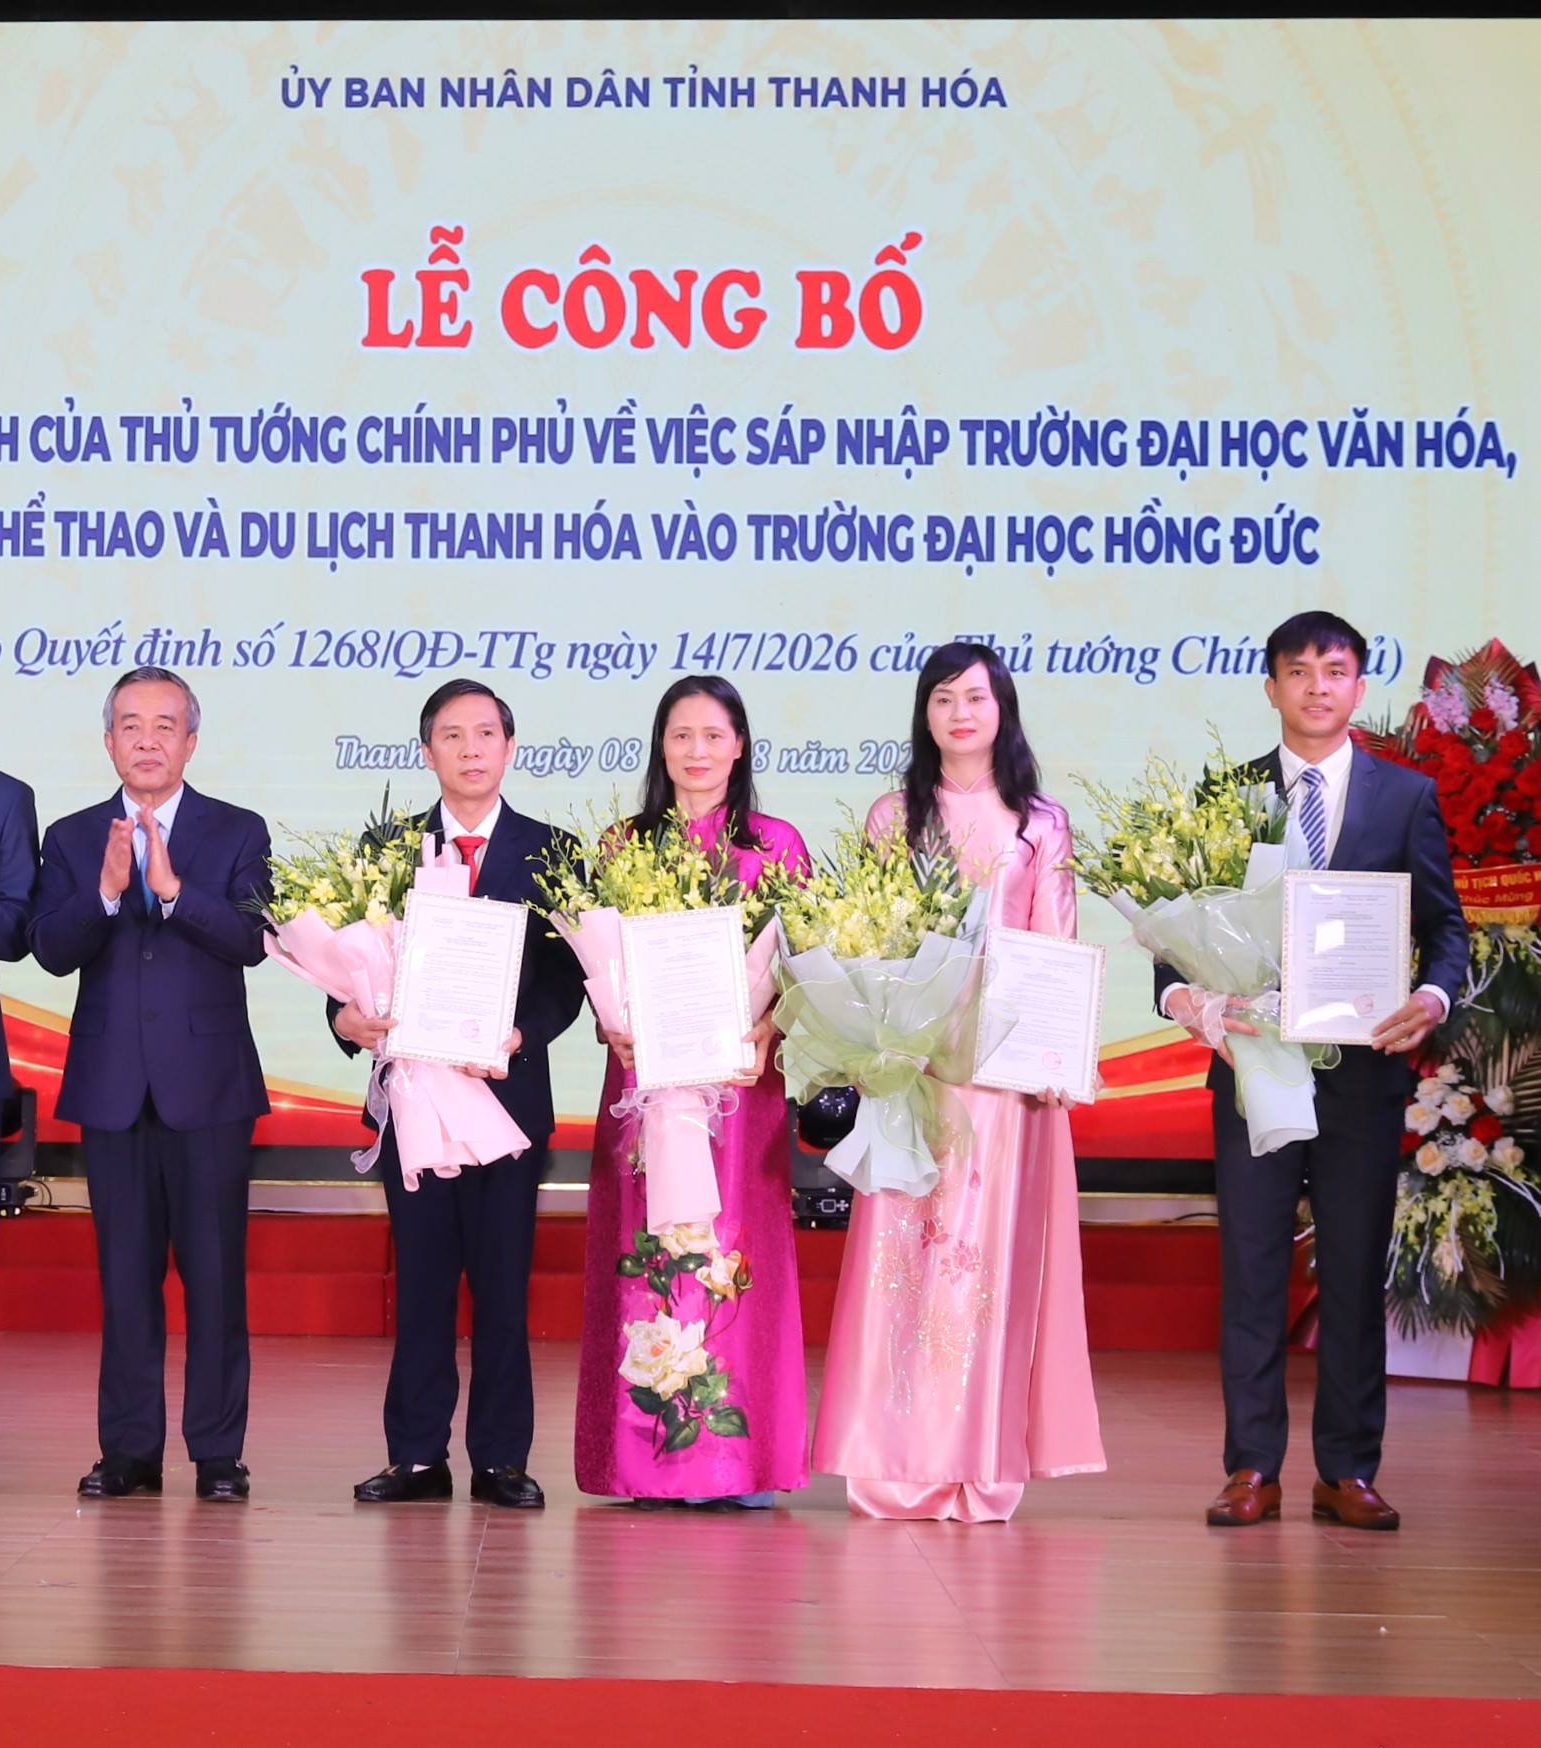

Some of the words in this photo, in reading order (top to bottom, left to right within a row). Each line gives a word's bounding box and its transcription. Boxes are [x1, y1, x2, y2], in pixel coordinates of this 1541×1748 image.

[282, 65, 332, 110] ỦY
[345, 78, 426, 110] BAN
[441, 70, 553, 109] NHÂN
[567, 69, 651, 109] DÂN
[663, 64, 757, 109] TỈNH
[768, 77, 907, 109] THANH
[922, 68, 1009, 110] HÓA
[361, 226, 474, 349] LỄ
[502, 245, 769, 351] CÔNG
[795, 232, 924, 351] BỐ
[30, 397, 113, 464] CỦA
[120, 398, 201, 465] THỦ
[210, 402, 348, 466] TƯỚNG
[357, 402, 482, 466] CHÍNH
[492, 399, 576, 466] PHỦ
[584, 399, 639, 466] VỀ
[646, 404, 738, 480] VIỆC
[746, 404, 828, 467] SÁP
[837, 405, 952, 481] NHẬP
[960, 405, 1129, 469] TRƯỜNG
[1137, 420, 1211, 483] ĐẠI
[1221, 420, 1310, 483] HỌC
[1317, 408, 1405, 469] VĂN
[1416, 407, 1518, 481] HÓA,
[54, 510, 166, 560] THAO
[174, 498, 231, 559] VÀ
[241, 512, 297, 561] DU
[308, 512, 395, 574] LỊCH
[405, 513, 544, 561] THANH
[555, 499, 644, 562] HÓA
[651, 500, 739, 563] VÀO
[747, 501, 916, 564] TRƯỜNG
[923, 516, 997, 578] ĐẠI
[1007, 515, 1096, 578] HỌC
[1105, 498, 1223, 567] HỒNG
[1230, 503, 1322, 567] ĐỨC
[13, 620, 127, 677] Quyết
[233, 621, 286, 668] số
[288, 629, 558, 680] 1268/QĐ-TTg
[566, 631, 659, 680] ngày
[669, 632, 859, 673] 14/7/2026
[1046, 635, 1162, 686] tướng
[1171, 634, 1269, 676] Chín
[335, 735, 426, 769] Thanh
[514, 738, 593, 777] ngày
[599, 737, 642, 771] 08
[776, 741, 849, 774] năm
